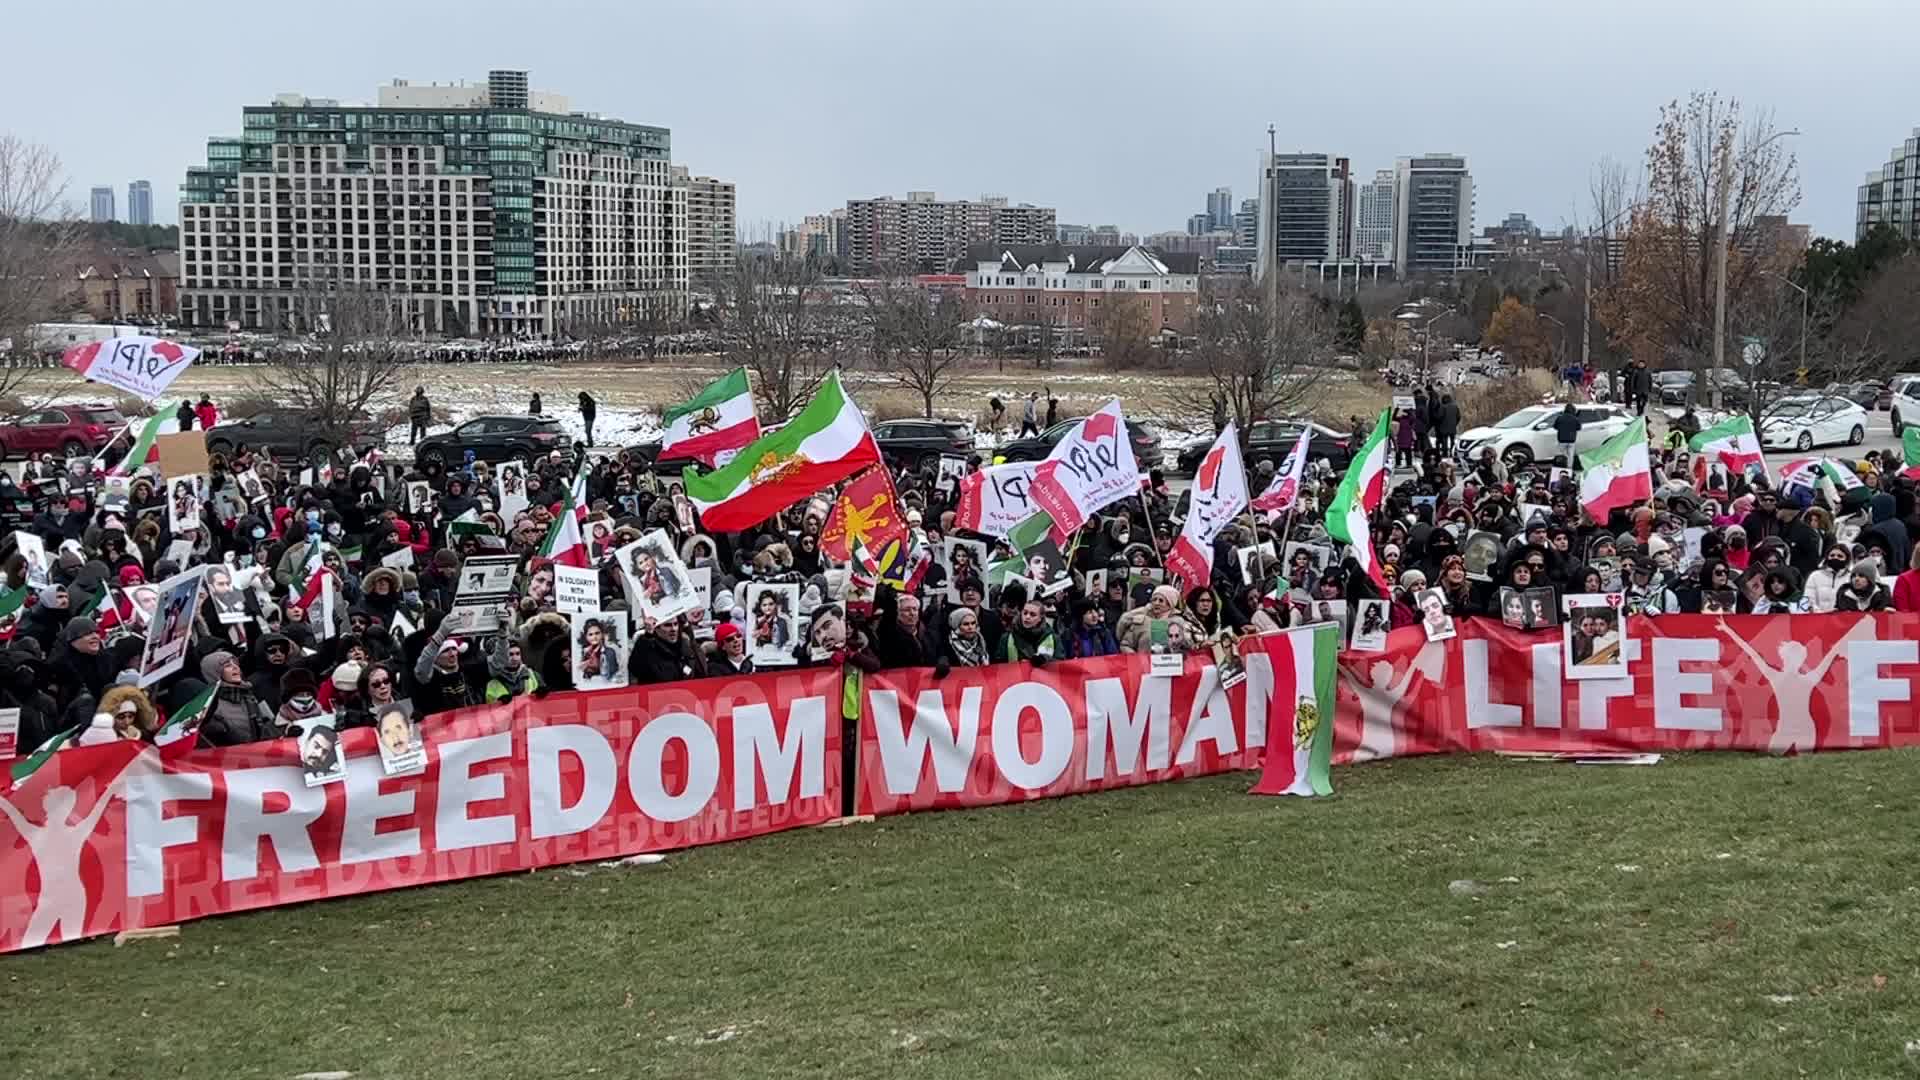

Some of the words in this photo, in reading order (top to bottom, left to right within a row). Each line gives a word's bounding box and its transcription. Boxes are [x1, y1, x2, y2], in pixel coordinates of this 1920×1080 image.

[565, 576, 596, 587] SOLIDARITY
[570, 587, 584, 595] WITH
[577, 597, 598, 606] WOMEN
[126, 696, 826, 897] FREEDOM
[1462, 637, 1723, 731] LIFE
